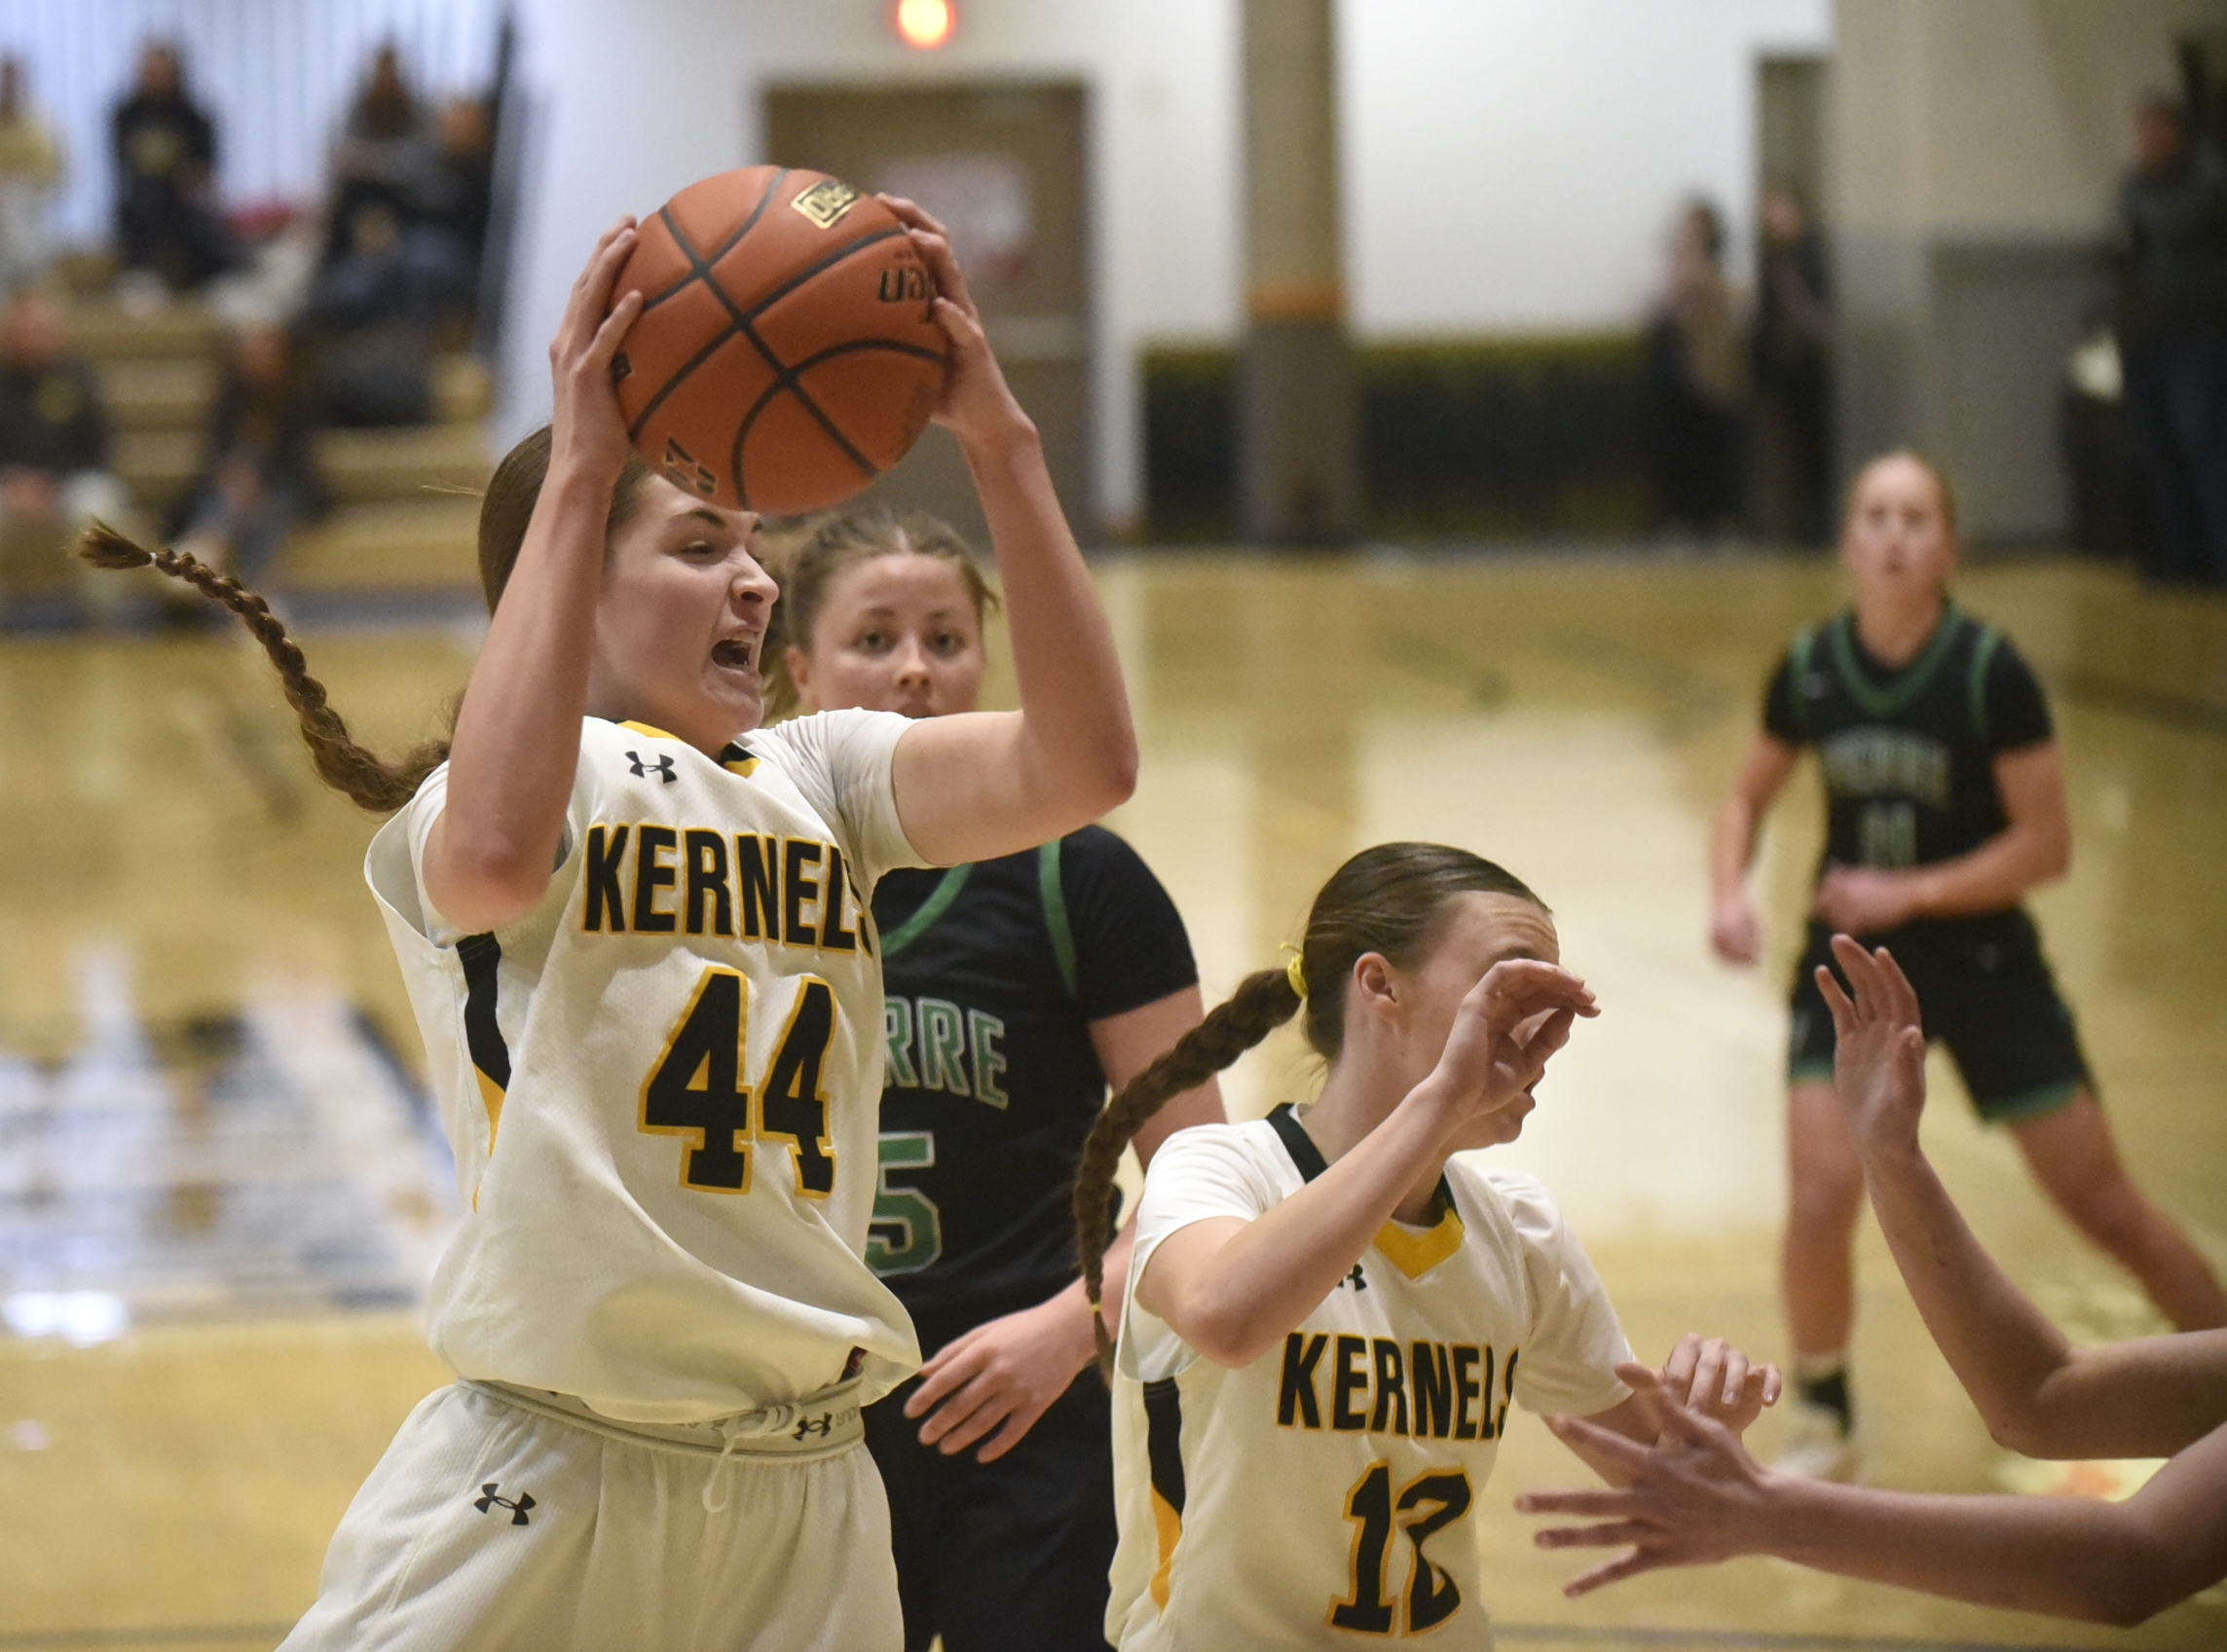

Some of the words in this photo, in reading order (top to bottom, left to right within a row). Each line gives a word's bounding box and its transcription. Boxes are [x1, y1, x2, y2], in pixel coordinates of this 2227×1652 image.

[637, 965, 837, 1198] 44
[882, 994, 1009, 1110] RRE
[1324, 1457, 1474, 1638] 12
